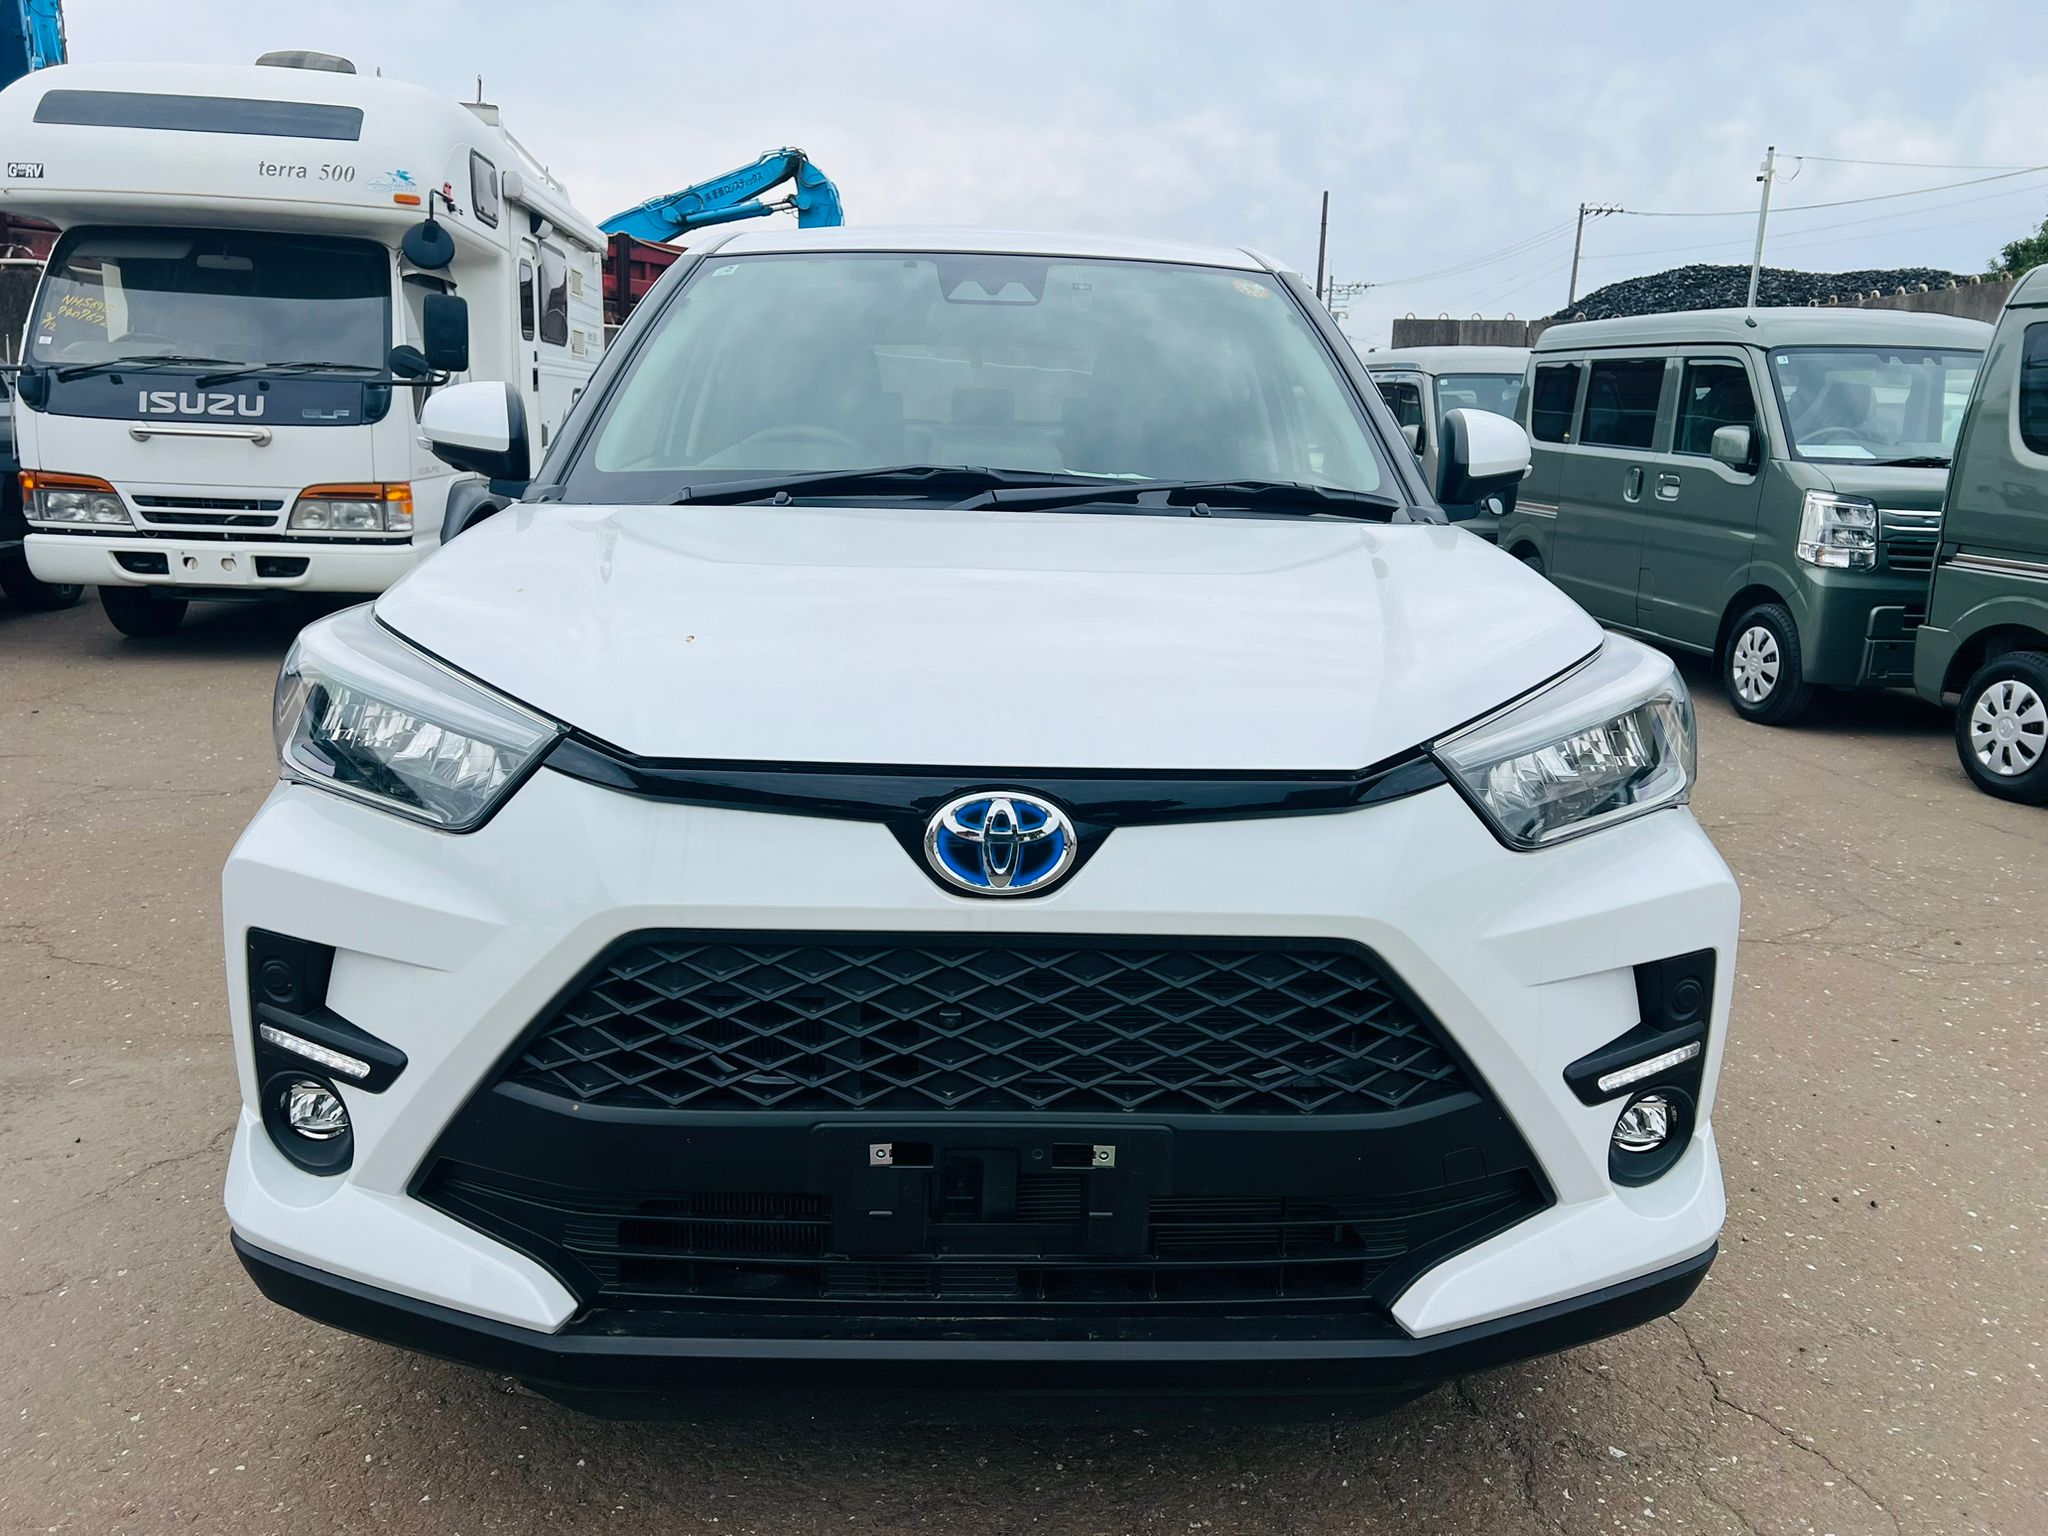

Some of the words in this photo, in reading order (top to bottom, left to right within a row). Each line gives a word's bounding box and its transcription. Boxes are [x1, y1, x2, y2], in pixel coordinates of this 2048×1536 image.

[259, 160, 307, 179] terra
[319, 164, 355, 183] 500
[138, 391, 265, 417] ISUZU
